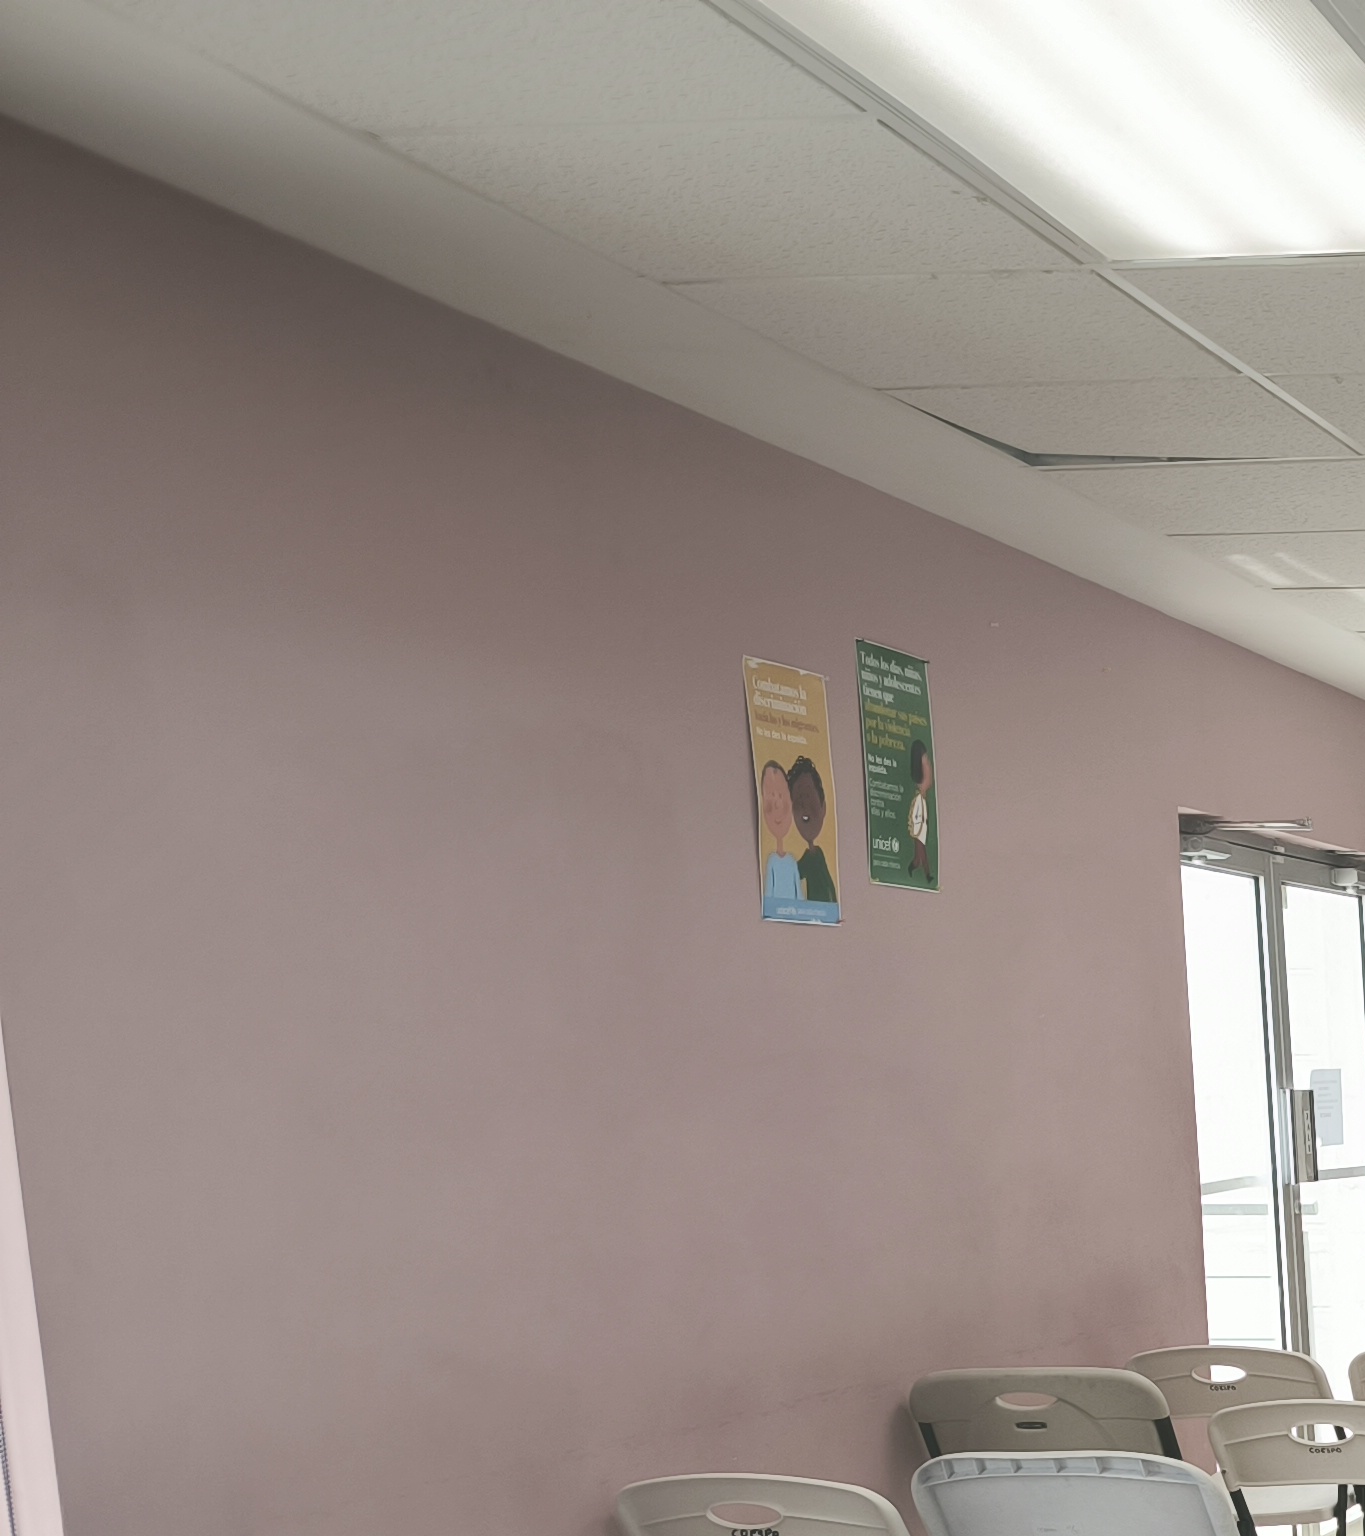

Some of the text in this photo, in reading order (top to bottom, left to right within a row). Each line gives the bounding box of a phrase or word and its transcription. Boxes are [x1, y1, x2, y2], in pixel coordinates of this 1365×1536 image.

[860, 651, 880, 668] Todos
[881, 656, 890, 671] los
[752, 675, 799, 699] Combatamos
[884, 673, 921, 696] adolescentes
[872, 835, 892, 852] unicef
